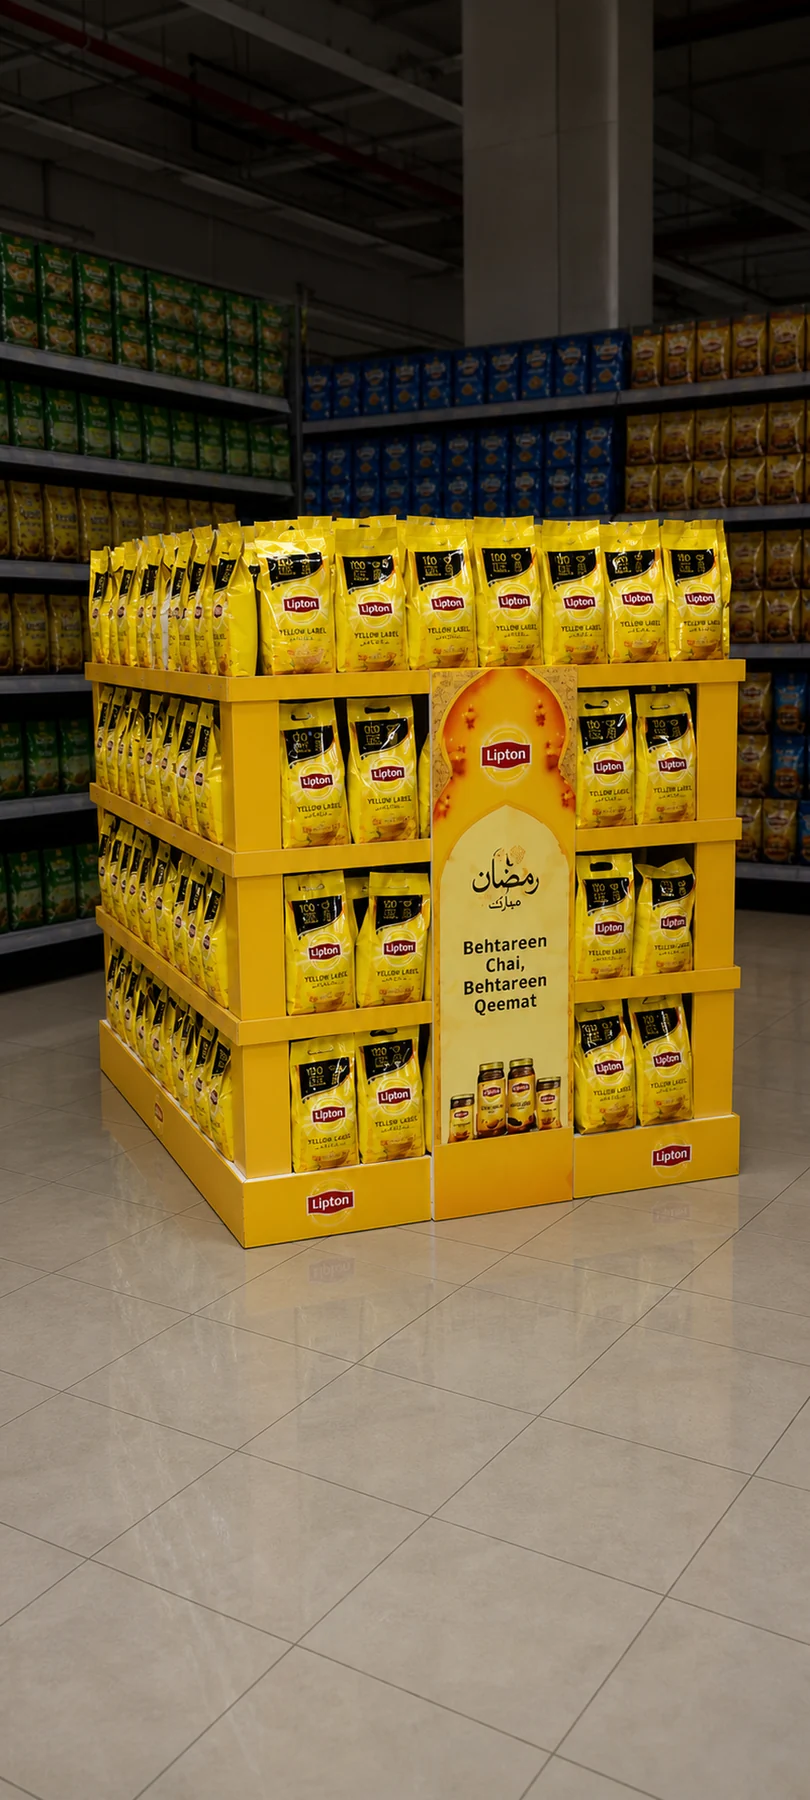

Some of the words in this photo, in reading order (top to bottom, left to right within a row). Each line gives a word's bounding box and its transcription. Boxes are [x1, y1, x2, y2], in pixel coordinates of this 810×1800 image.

[286, 599, 317, 610] Lipton
[434, 598, 463, 609] Lipton
[500, 597, 529, 607] Lipton
[565, 598, 593, 608] Lipton
[624, 594, 652, 604] Lipton
[687, 594, 714, 604] Lipton
[361, 604, 390, 615] Lipton
[487, 748, 526, 764] Lipton
[596, 763, 622, 772] Lipton
[661, 761, 685, 770] Lipton
[373, 769, 402, 780] Lipton
[303, 777, 331, 787] Lipton
[472, 855, 539, 894] رمضان
[488, 896, 521, 911] مبارك
[597, 924, 622, 934] Lipton
[386, 943, 413, 954] Lipton
[463, 935, 547, 955] Behtareen
[311, 947, 338, 957] Lipton
[486, 955, 525, 973] Chai,
[463, 975, 547, 996] Behtareen
[474, 993, 537, 1016] Qeemat
[380, 1091, 409, 1103] Lipton
[314, 1109, 343, 1121] Lipton
[656, 1150, 688, 1164] Lipton
[312, 1196, 350, 1210] Lipton
